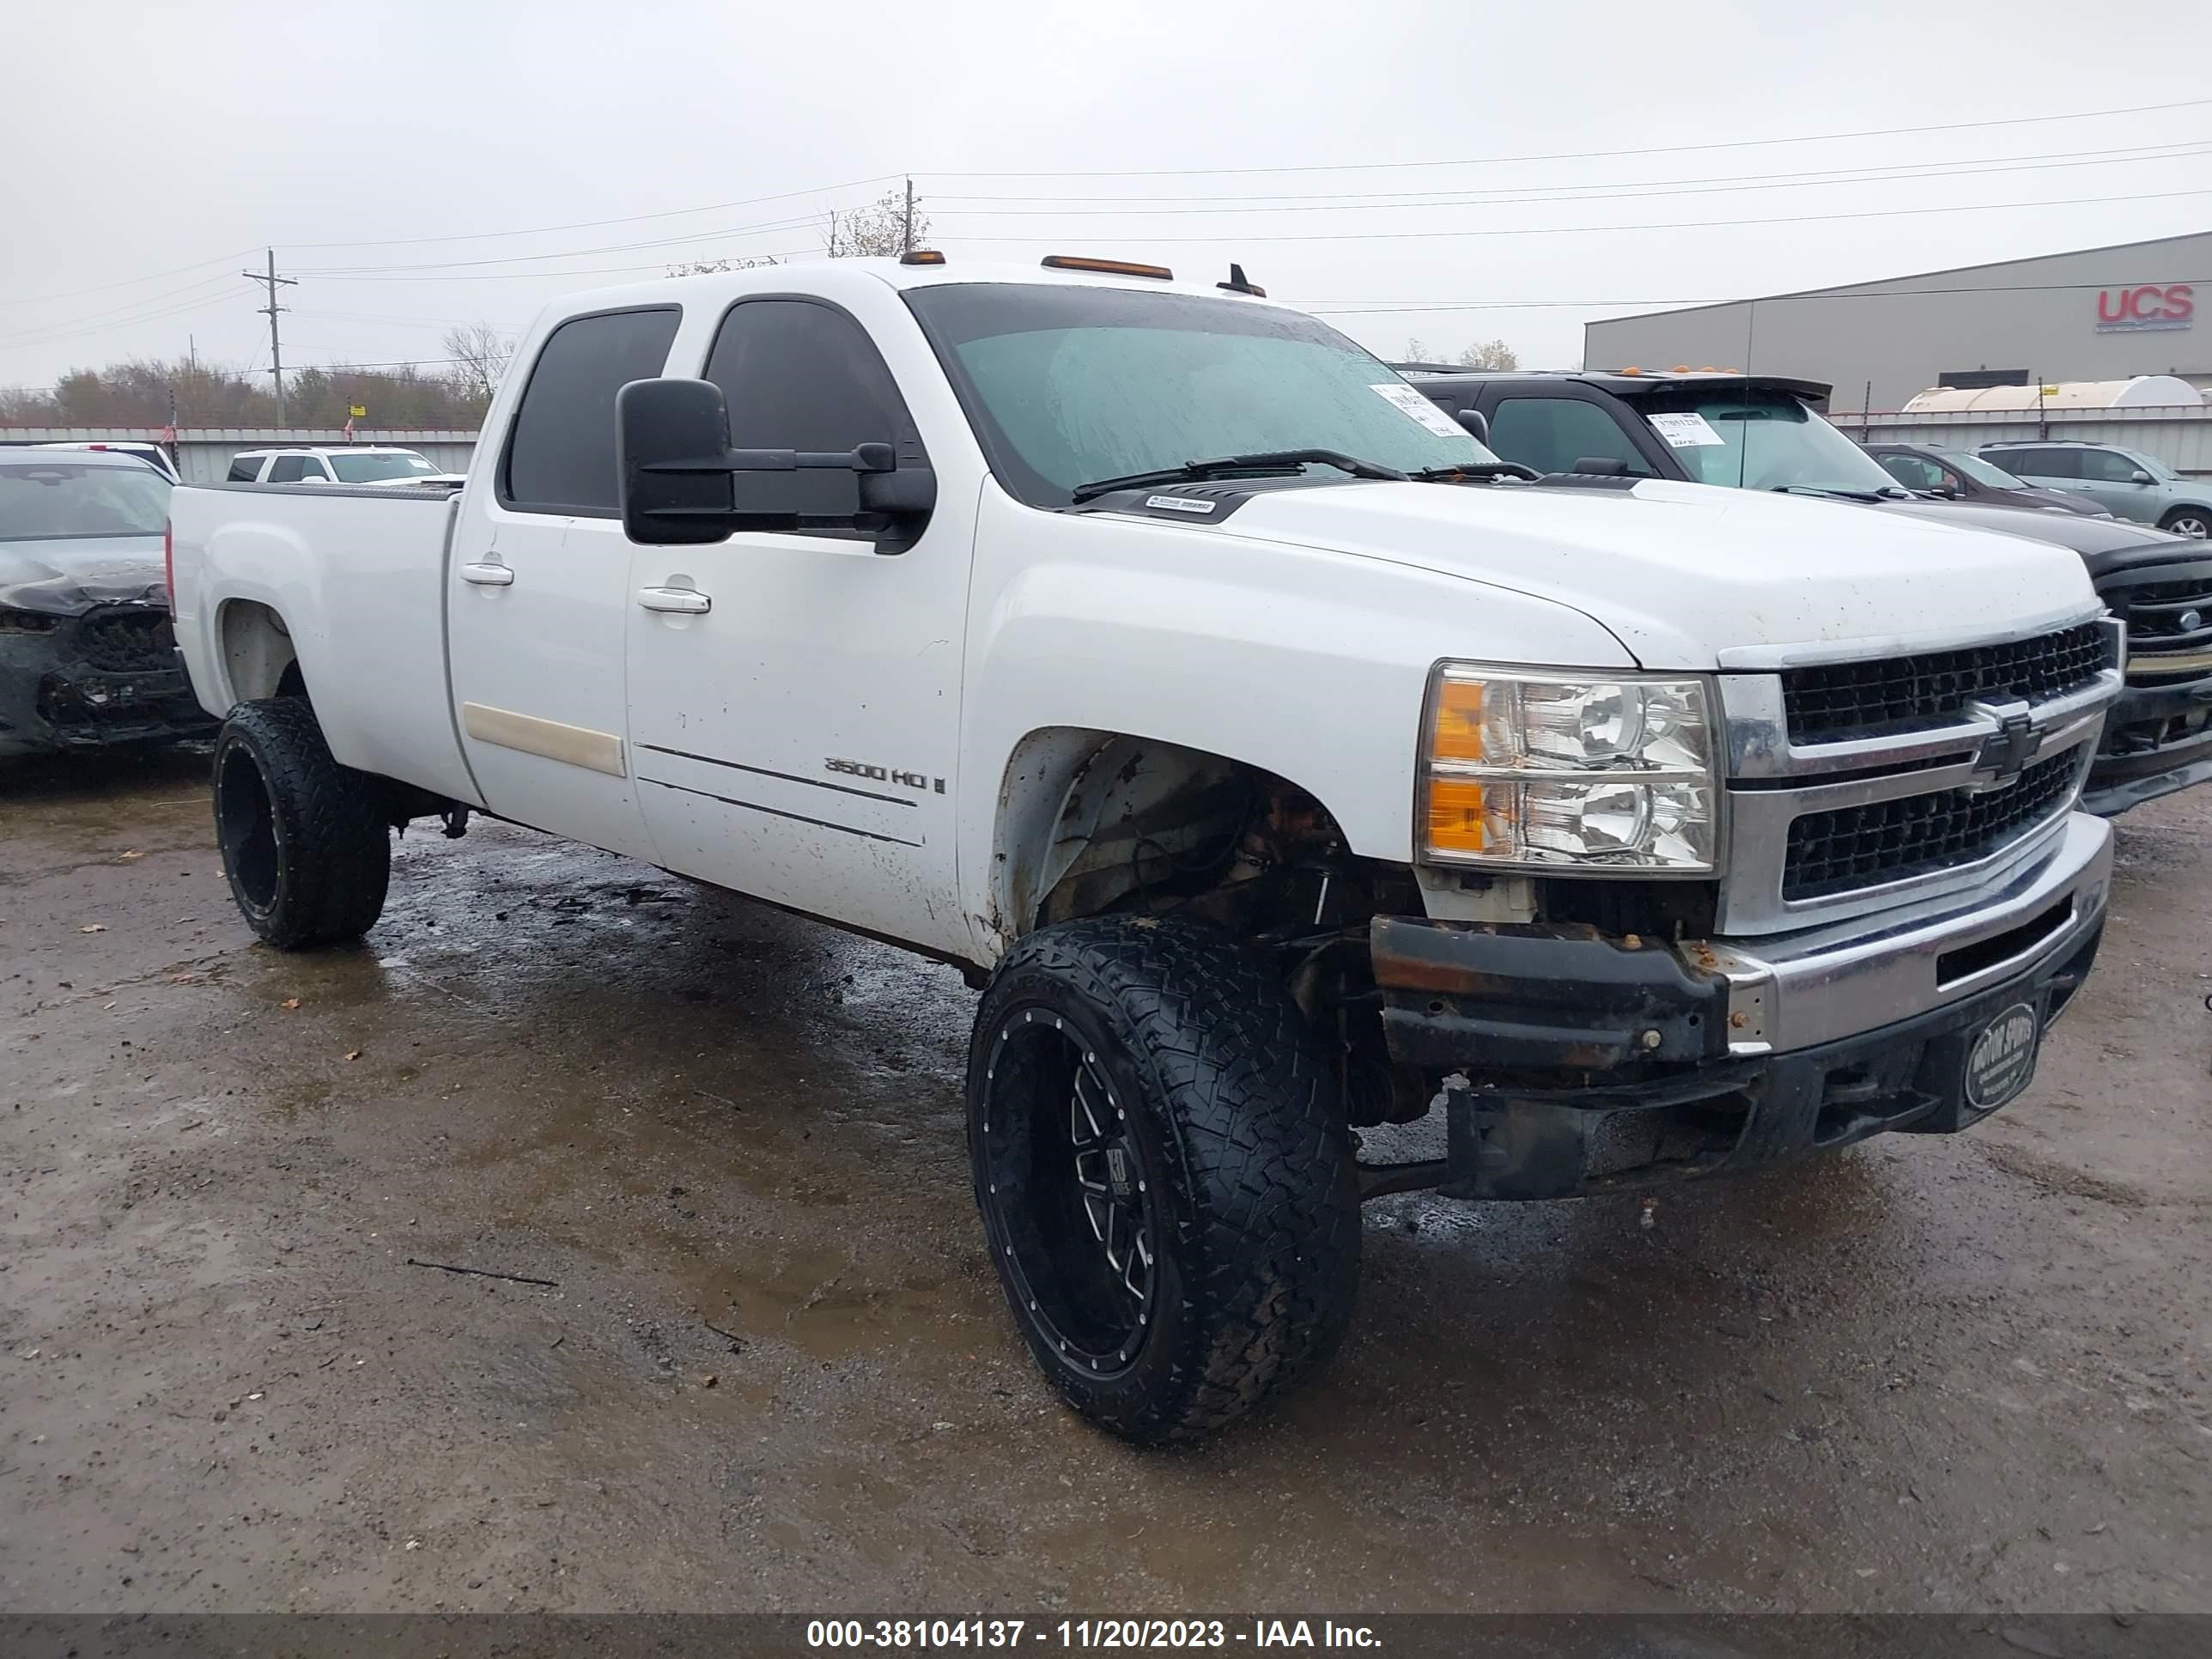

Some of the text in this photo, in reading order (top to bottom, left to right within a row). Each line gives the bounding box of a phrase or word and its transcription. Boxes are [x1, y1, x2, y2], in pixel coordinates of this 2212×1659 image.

[2098, 284, 2193, 322] UCS
[824, 757, 927, 789] 3500 HD
